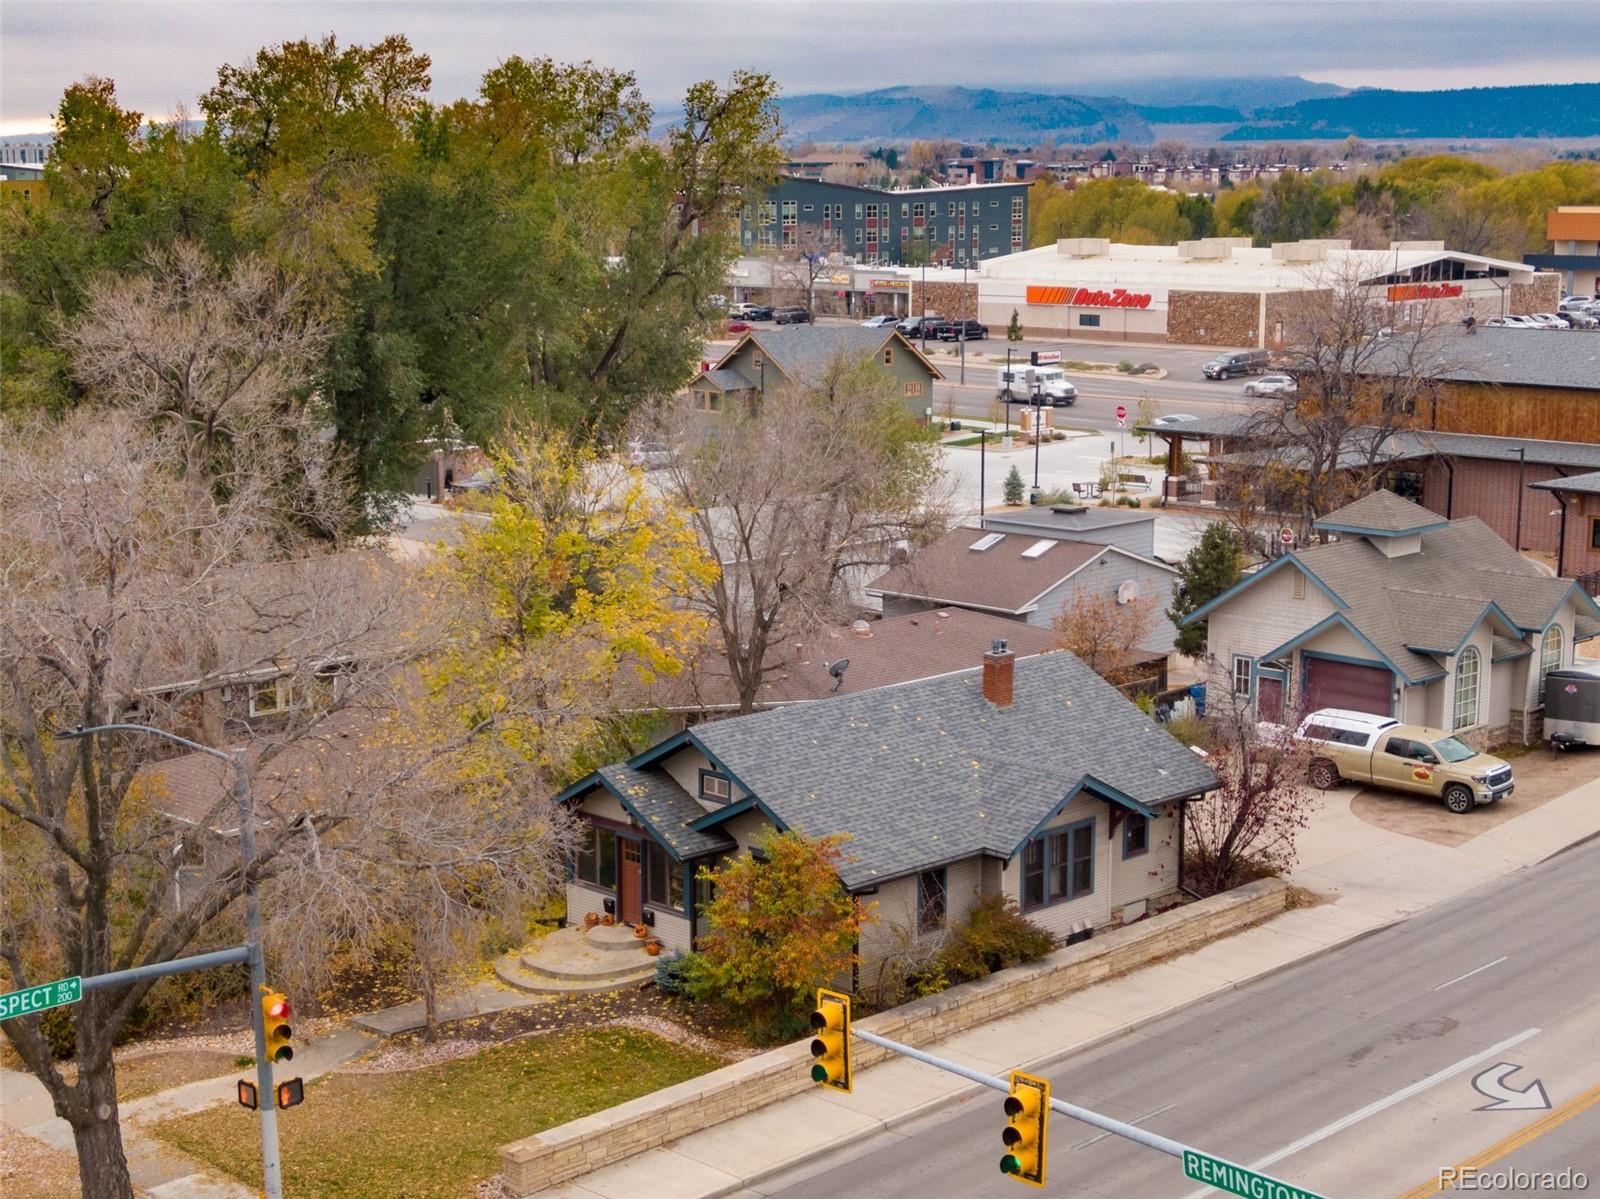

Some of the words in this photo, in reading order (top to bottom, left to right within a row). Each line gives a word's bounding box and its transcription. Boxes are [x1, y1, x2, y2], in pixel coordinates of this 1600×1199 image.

[1073, 288, 1152, 308] AutoZone
[0, 987, 52, 1016] SPECT
[57, 983, 69, 993] RD
[57, 991, 73, 1003] 200
